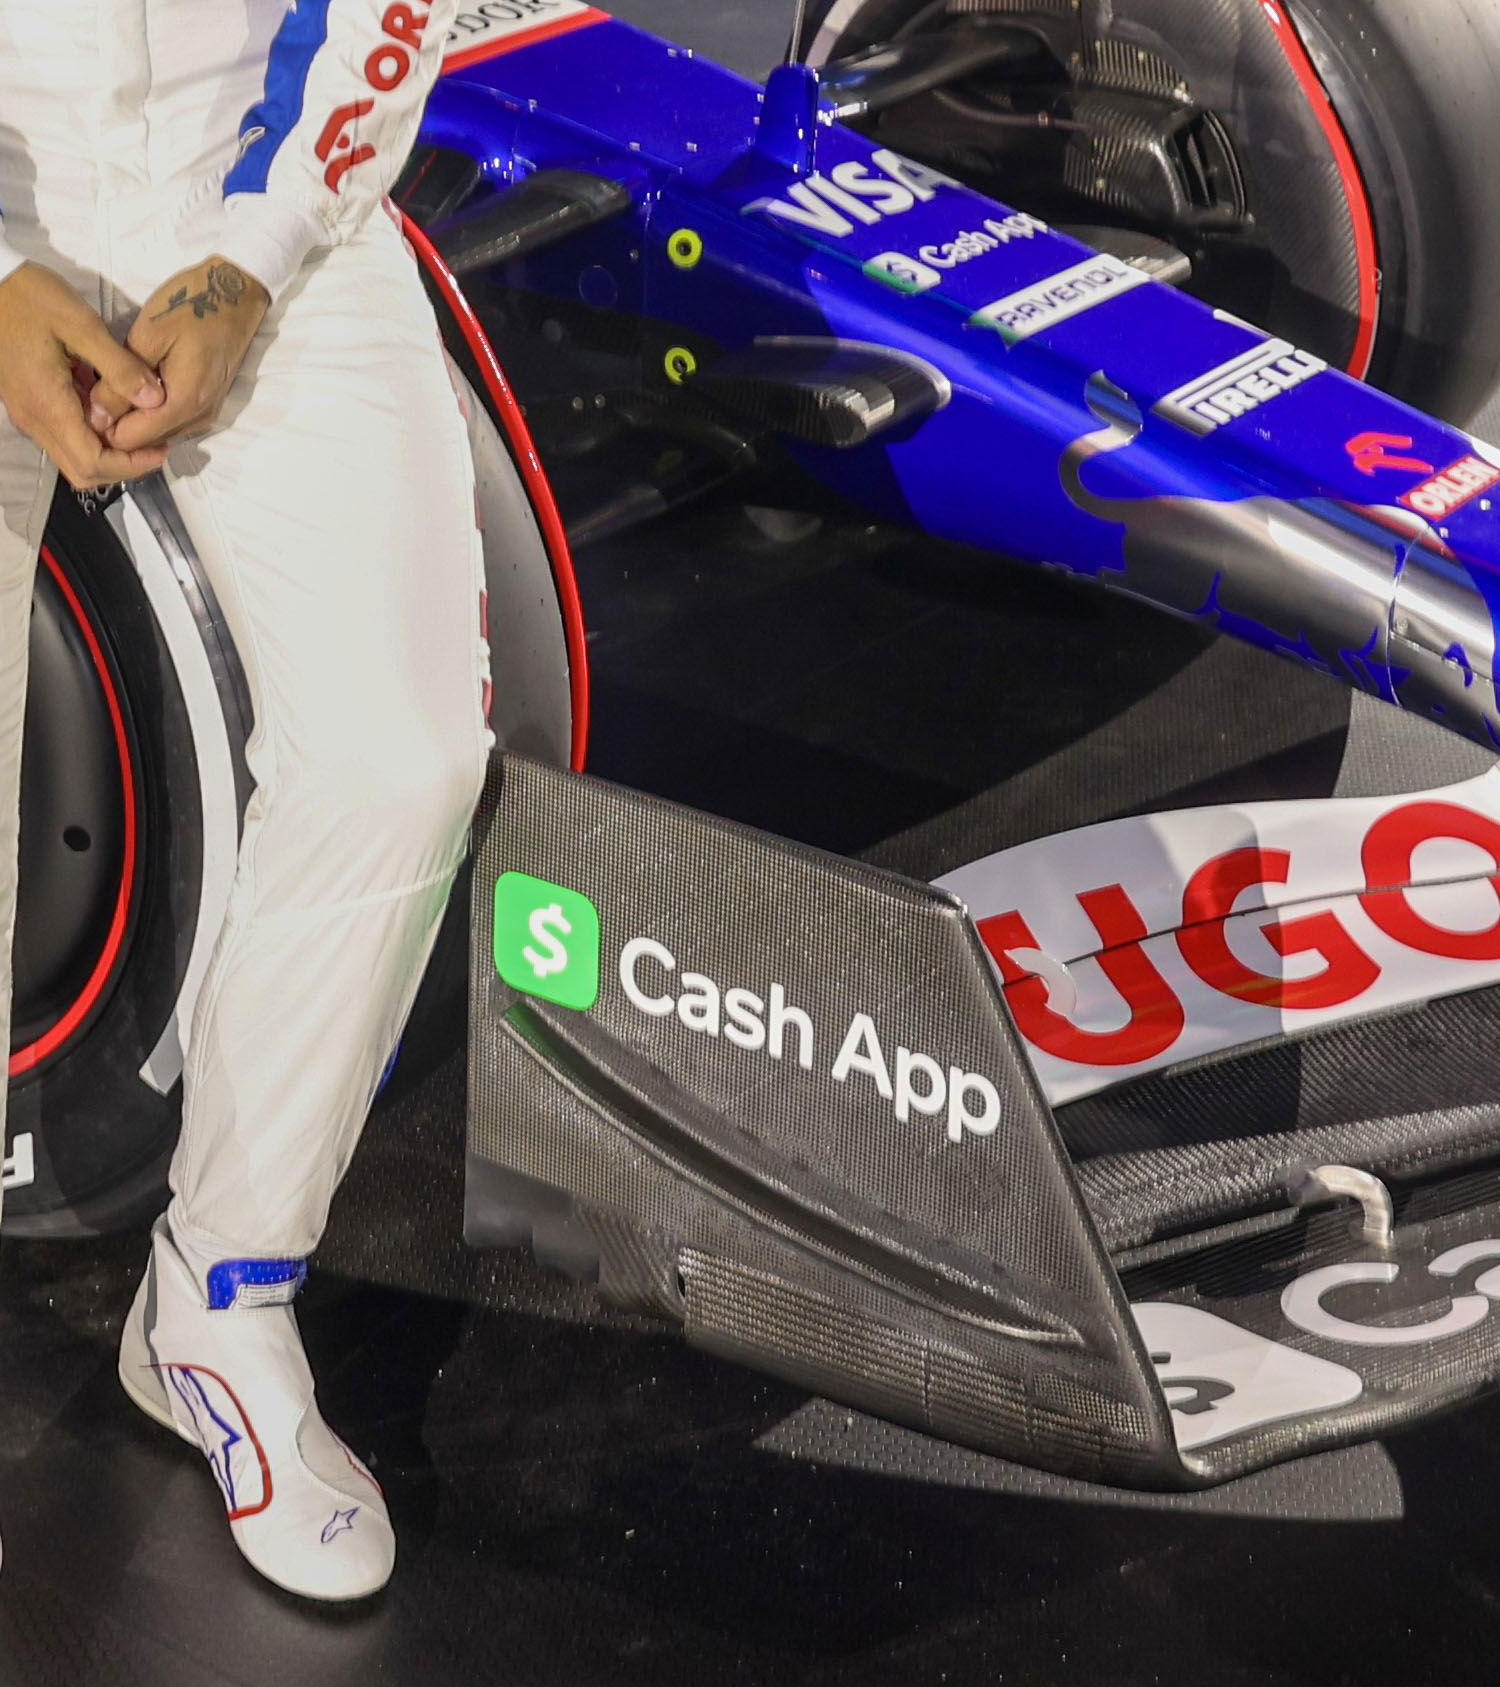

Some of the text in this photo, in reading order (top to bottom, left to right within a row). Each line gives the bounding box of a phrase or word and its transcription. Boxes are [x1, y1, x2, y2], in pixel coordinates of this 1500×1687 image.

[741, 148, 966, 238] VISA
[918, 225, 999, 270] Cash
[995, 265, 1129, 331] RAVENOL
[1152, 338, 1328, 439] PIRELLI
[1409, 456, 1500, 515] ORLEN
[618, 936, 815, 1072] Cash
[831, 1012, 1001, 1144] App
